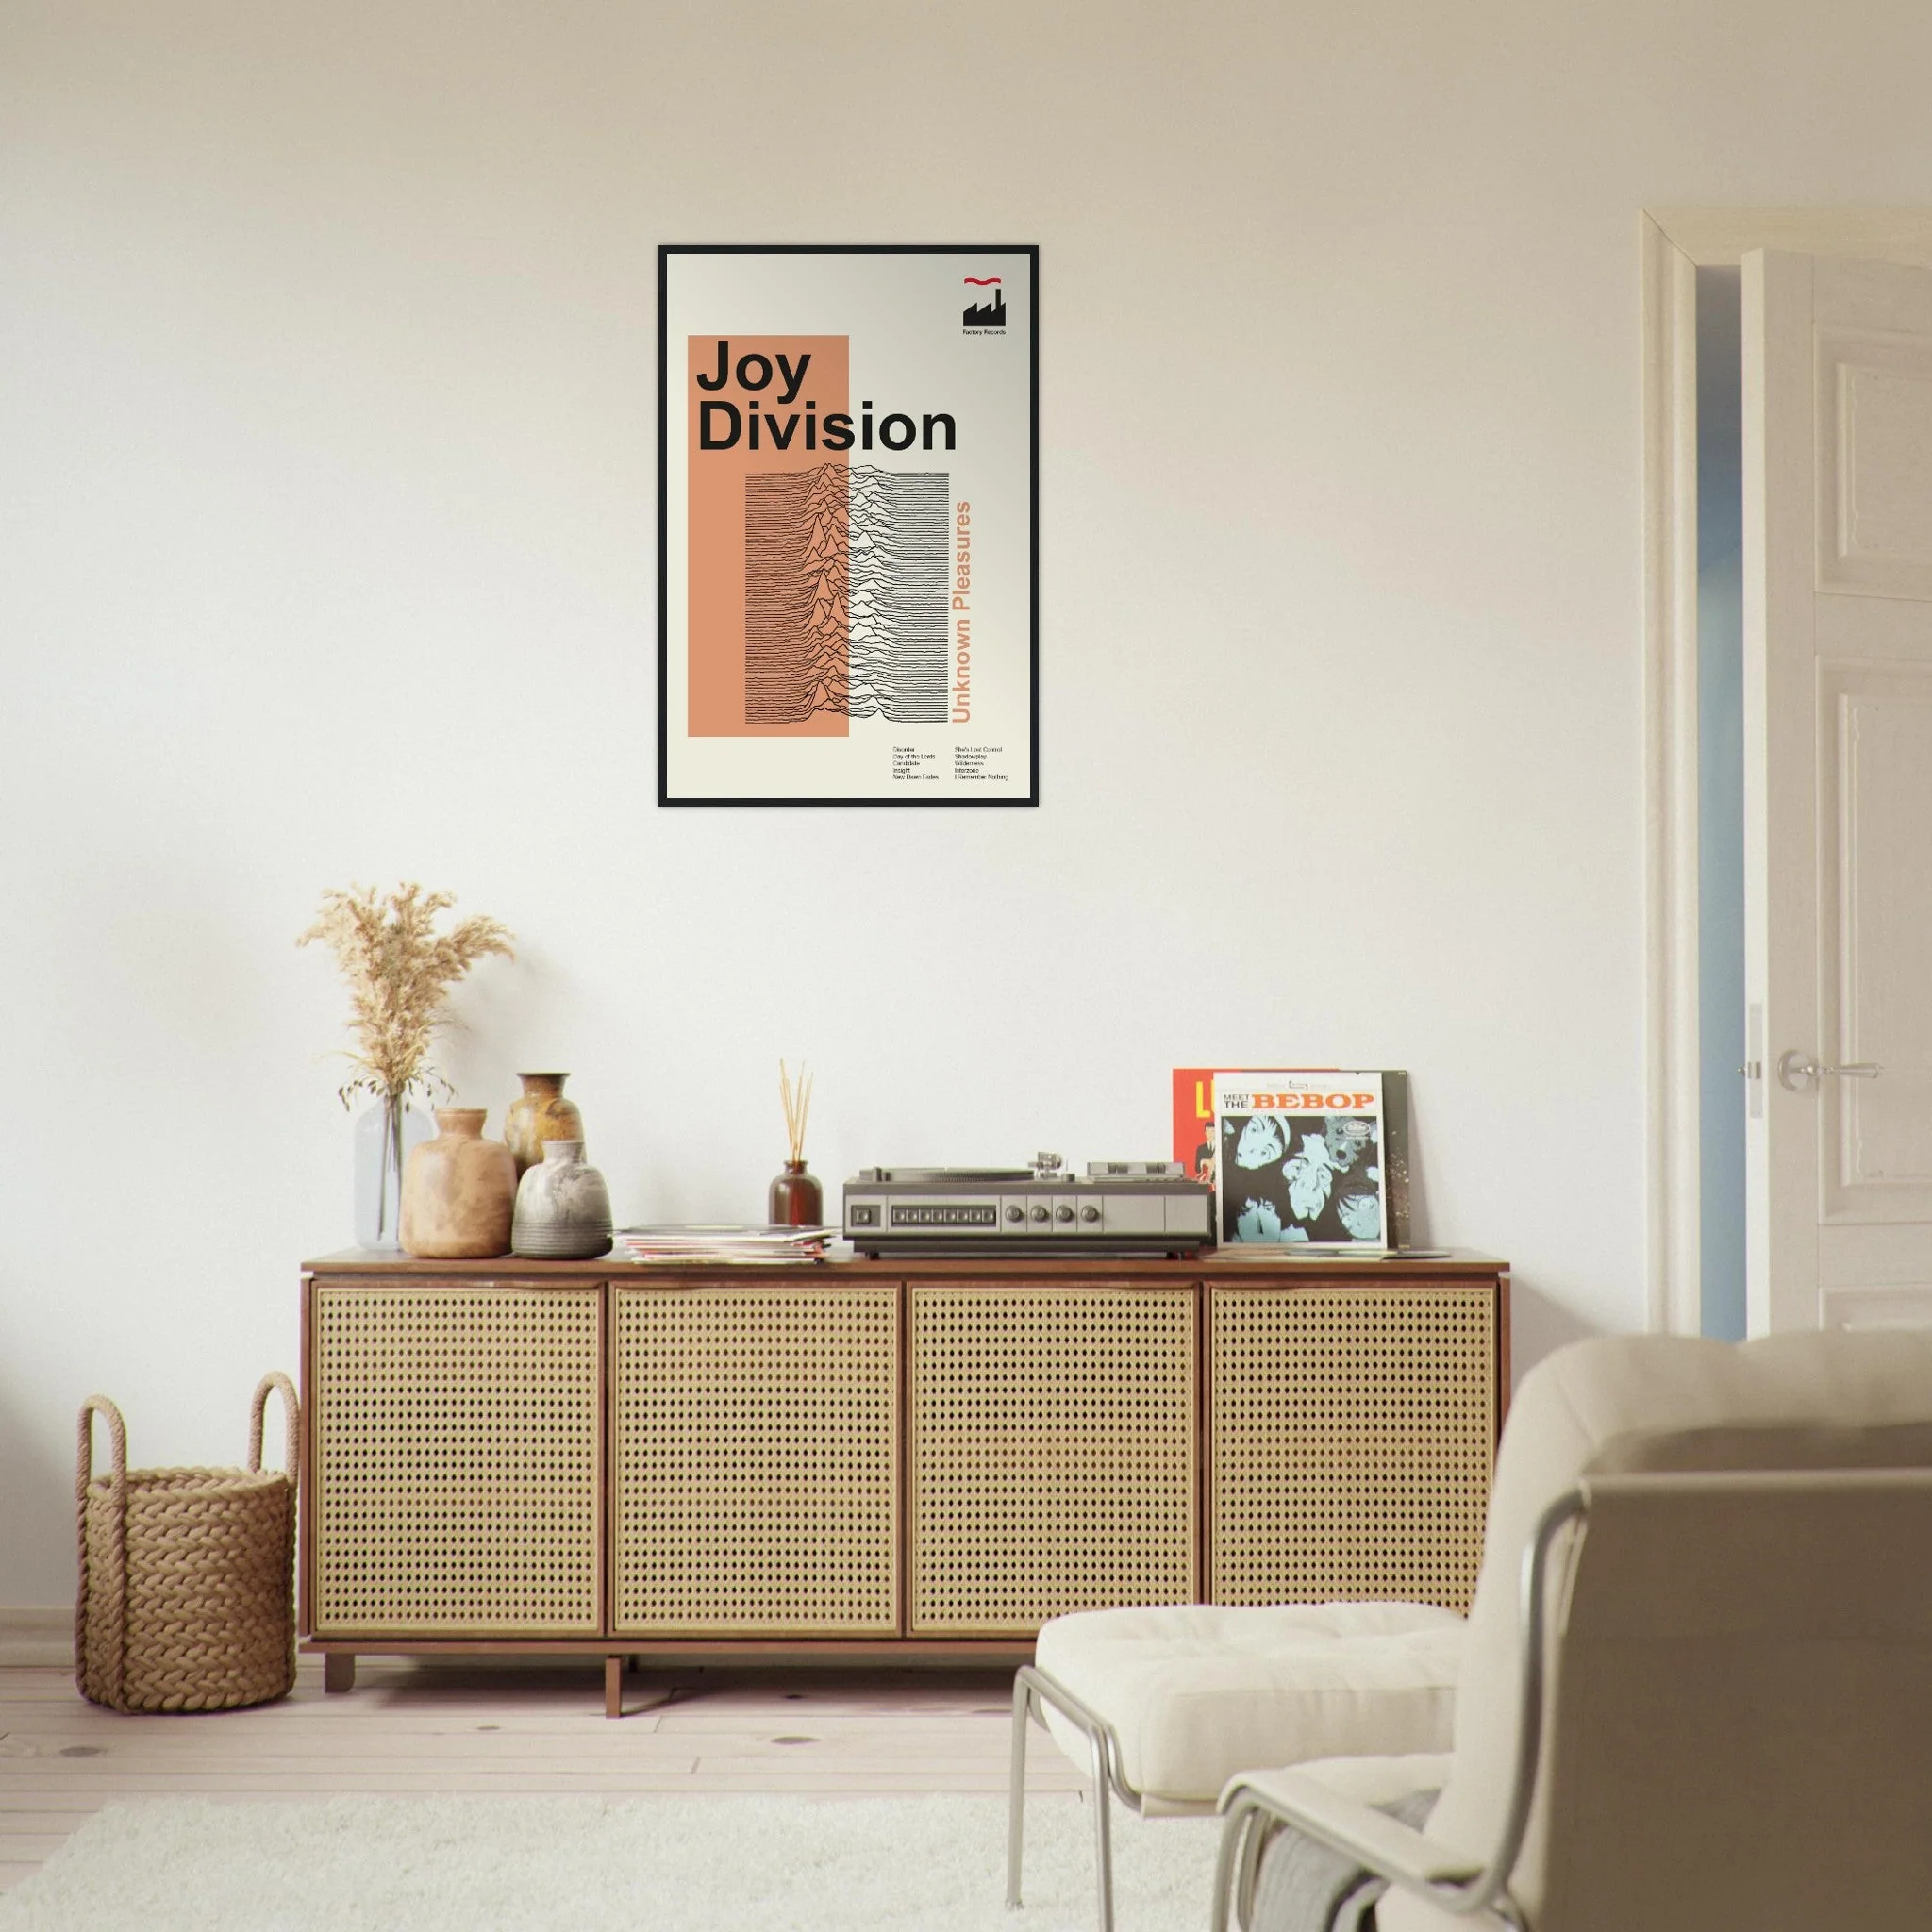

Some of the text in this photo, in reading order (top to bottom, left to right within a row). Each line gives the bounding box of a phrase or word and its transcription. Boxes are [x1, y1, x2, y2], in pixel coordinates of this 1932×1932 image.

[696, 341, 811, 404] Joy
[699, 400, 957, 452] Division
[952, 501, 971, 724] Unknown Pleasures
[1196, 1081, 1214, 1118] L
[1252, 1093, 1374, 1109] BEBOP
